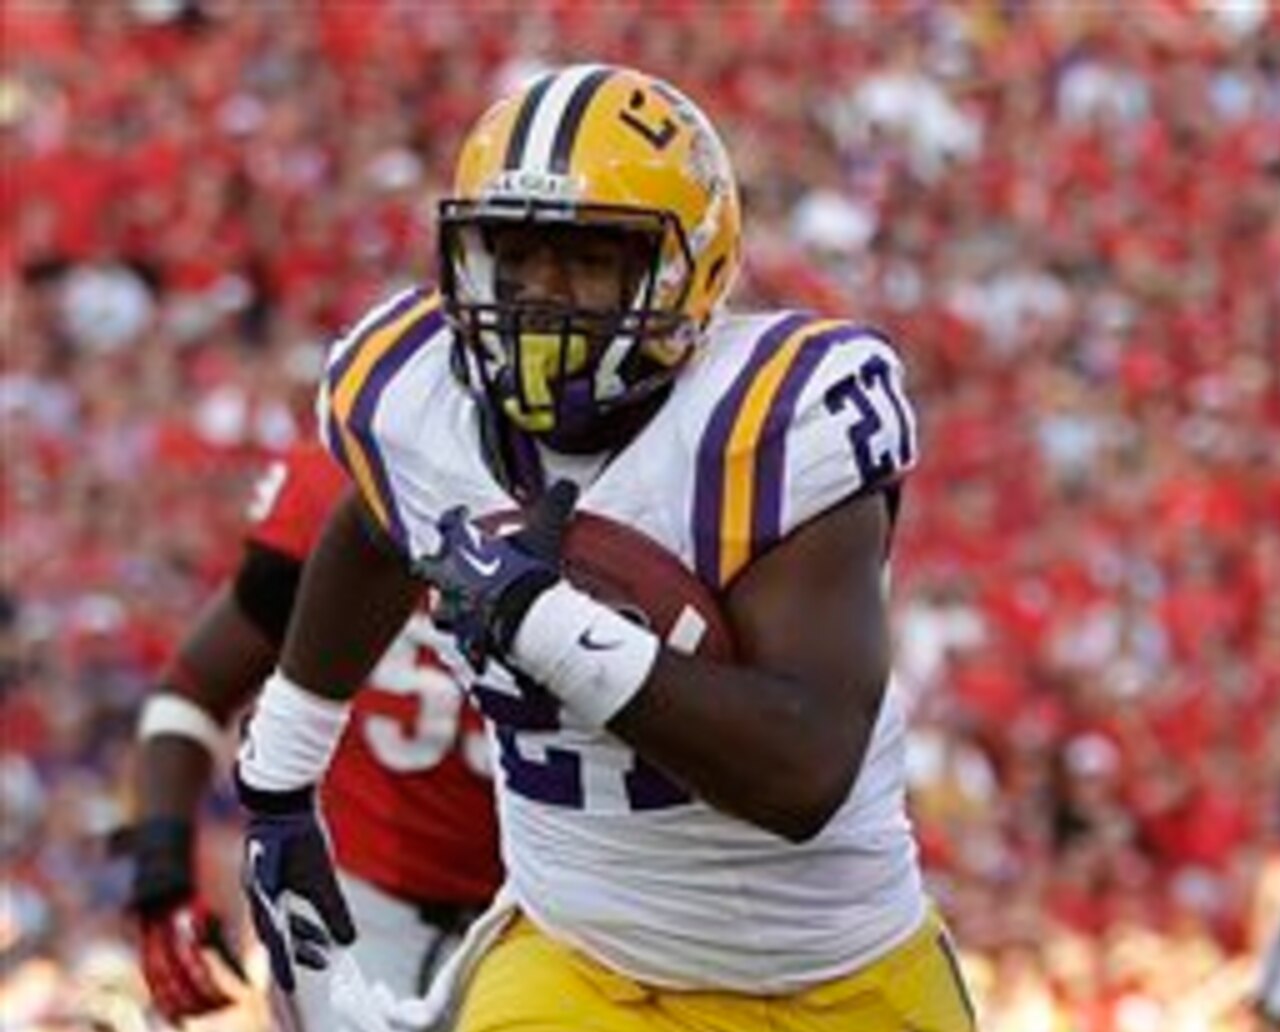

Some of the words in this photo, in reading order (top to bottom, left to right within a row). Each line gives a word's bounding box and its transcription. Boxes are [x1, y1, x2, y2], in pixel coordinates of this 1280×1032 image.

[824, 354, 912, 484] 27
[362, 612, 499, 780] 5
[470, 680, 697, 812] 2
